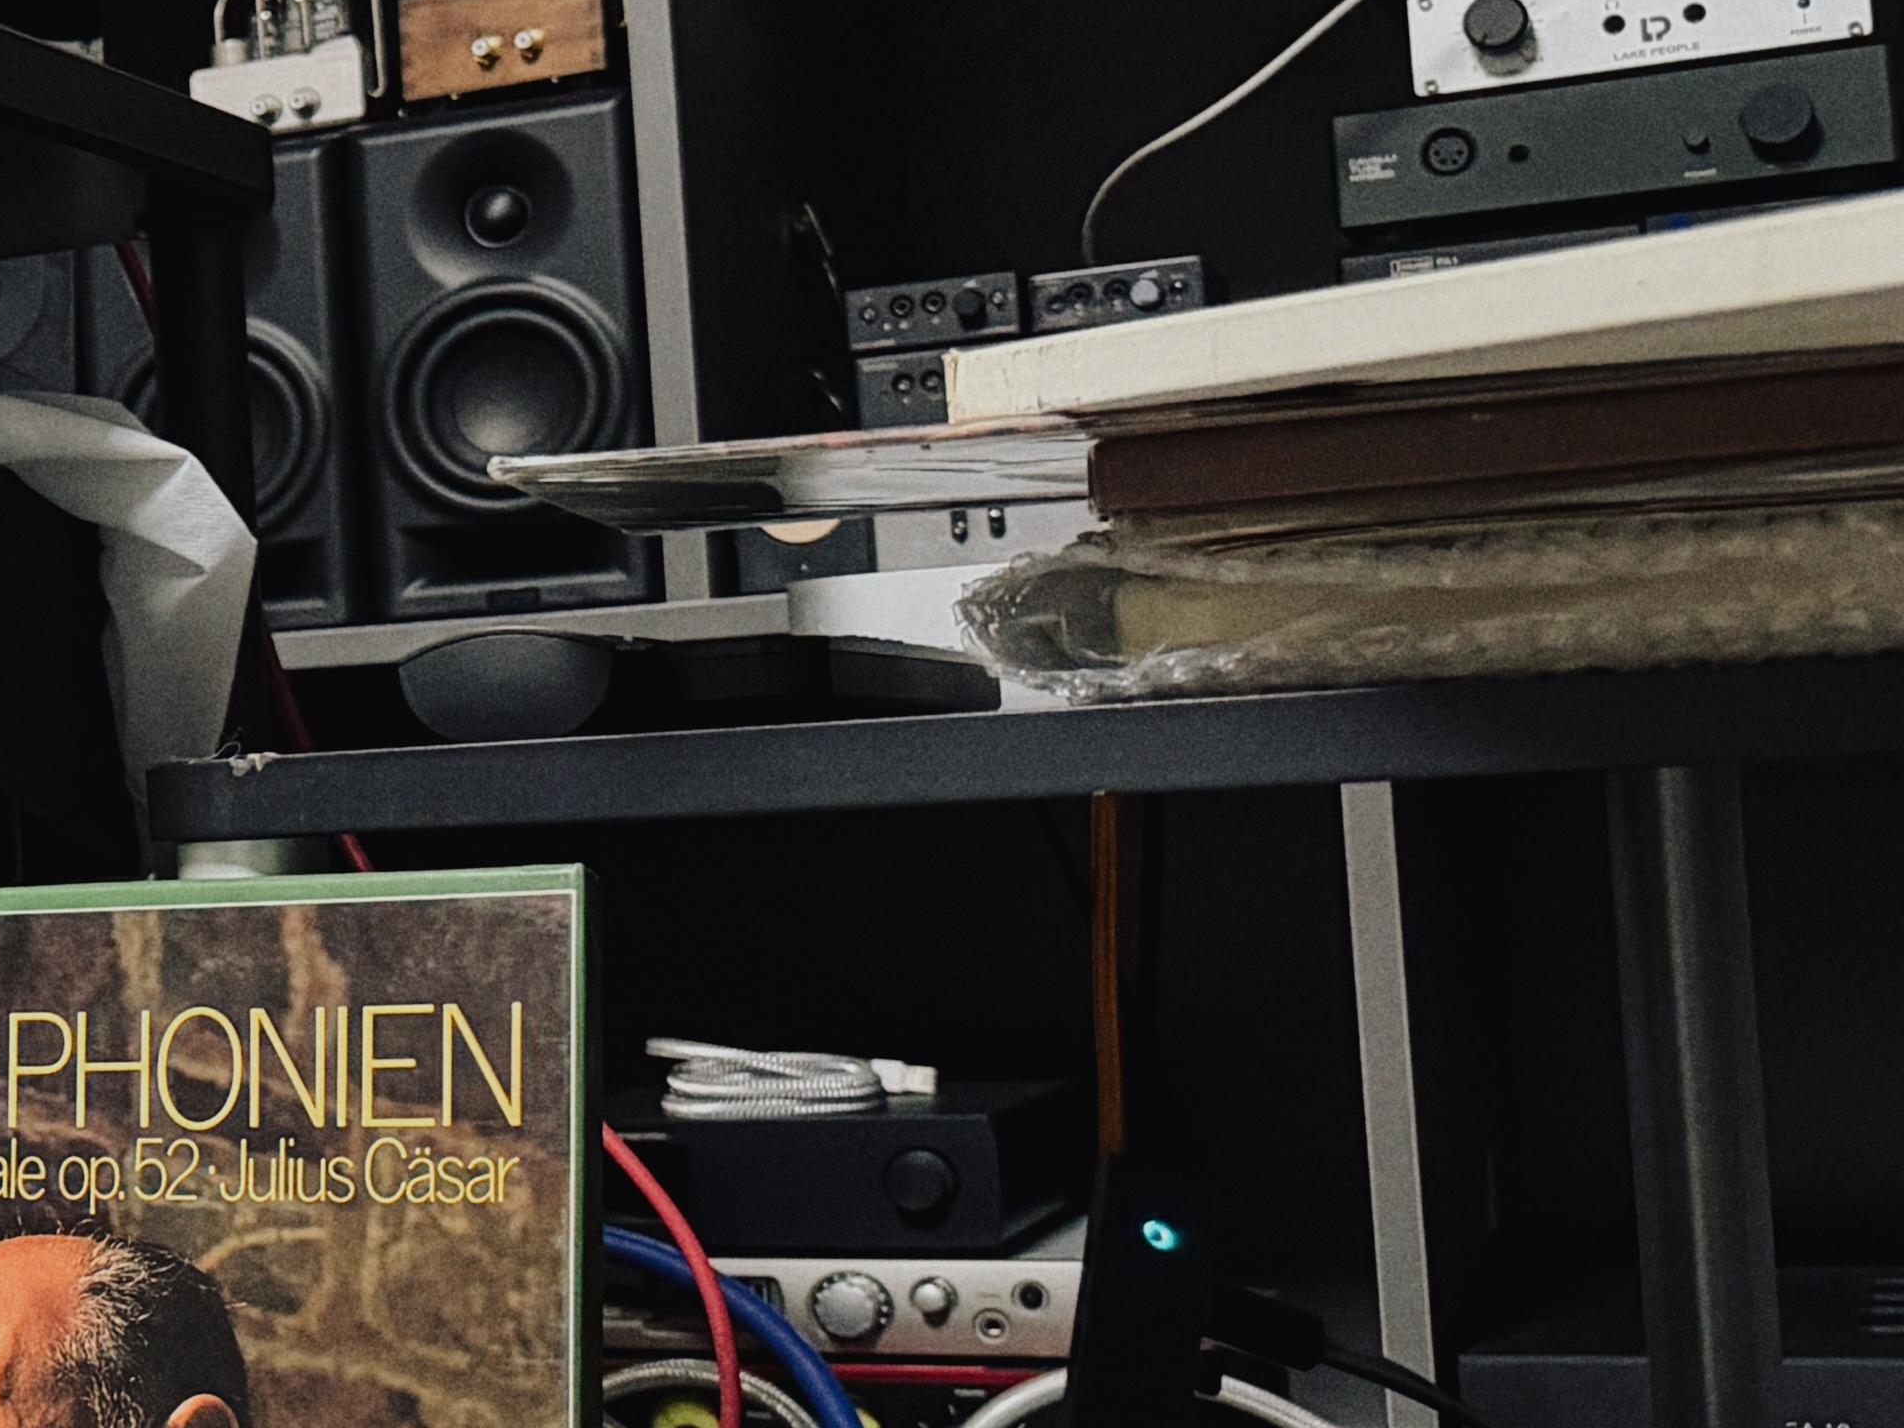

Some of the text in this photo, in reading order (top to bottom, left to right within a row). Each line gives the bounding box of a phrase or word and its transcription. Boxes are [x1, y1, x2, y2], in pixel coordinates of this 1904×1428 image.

[1613, 41, 1701, 62] LAKE PEOPLE
[58, 1155, 126, 1216] op.
[218, 1136, 357, 1204] Julius
[363, 1136, 521, 1205] Cäsar
